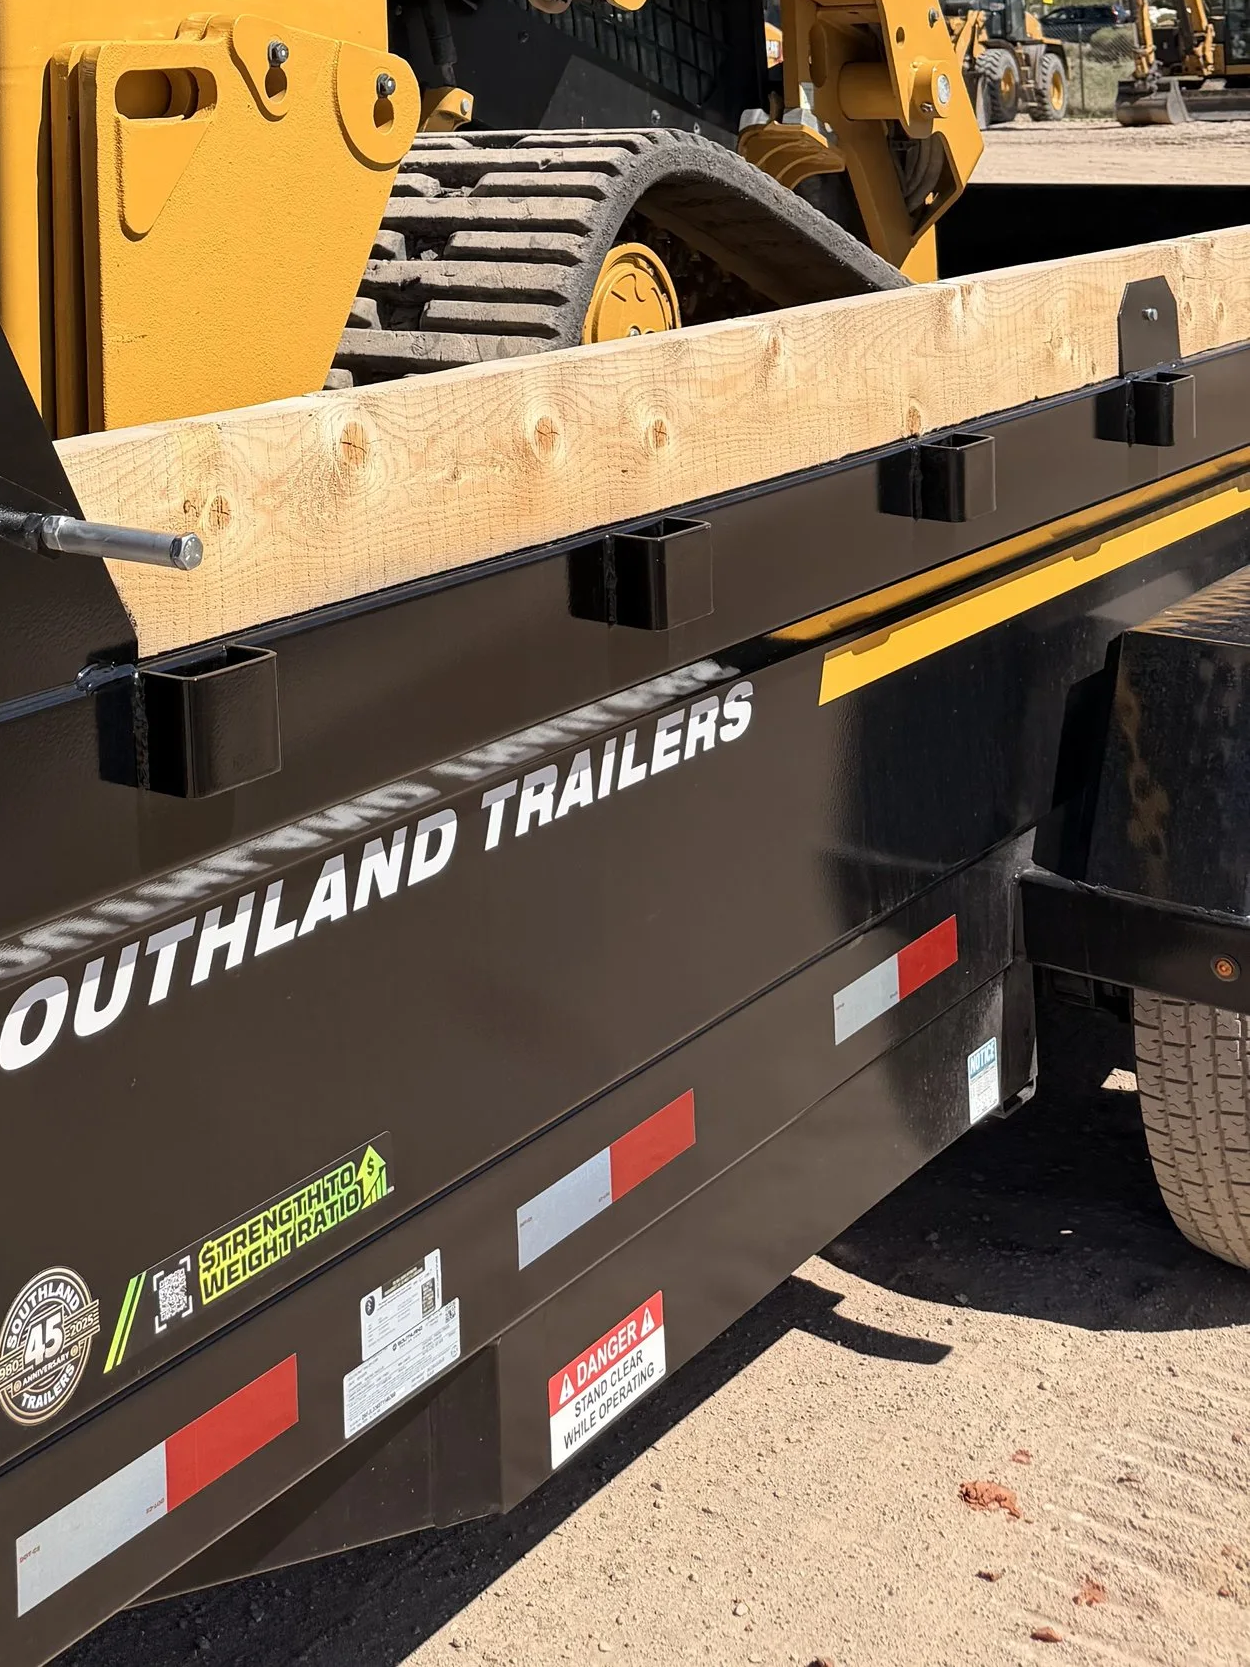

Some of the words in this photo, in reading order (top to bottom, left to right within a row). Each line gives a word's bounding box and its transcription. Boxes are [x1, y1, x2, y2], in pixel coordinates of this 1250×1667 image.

[481, 680, 754, 851] TRAILERS
[326, 1163, 355, 1196] TO
[203, 1228, 295, 1299] WEIGHT
[297, 1189, 360, 1245] RATIO
[6, 1281, 81, 1349] SOUTHLAND
[24, 1313, 63, 1366] 45
[69, 1314, 94, 1337] 2025
[20, 1363, 75, 1409] TRAILERS
[22, 1352, 69, 1387] ANNIVERSARY
[574, 1378, 608, 1418] STAND
[610, 1349, 644, 1387] CLEAR
[576, 1320, 637, 1388] DANGER
[563, 1410, 597, 1450] WHILE
[599, 1361, 655, 1420] OPERATING
